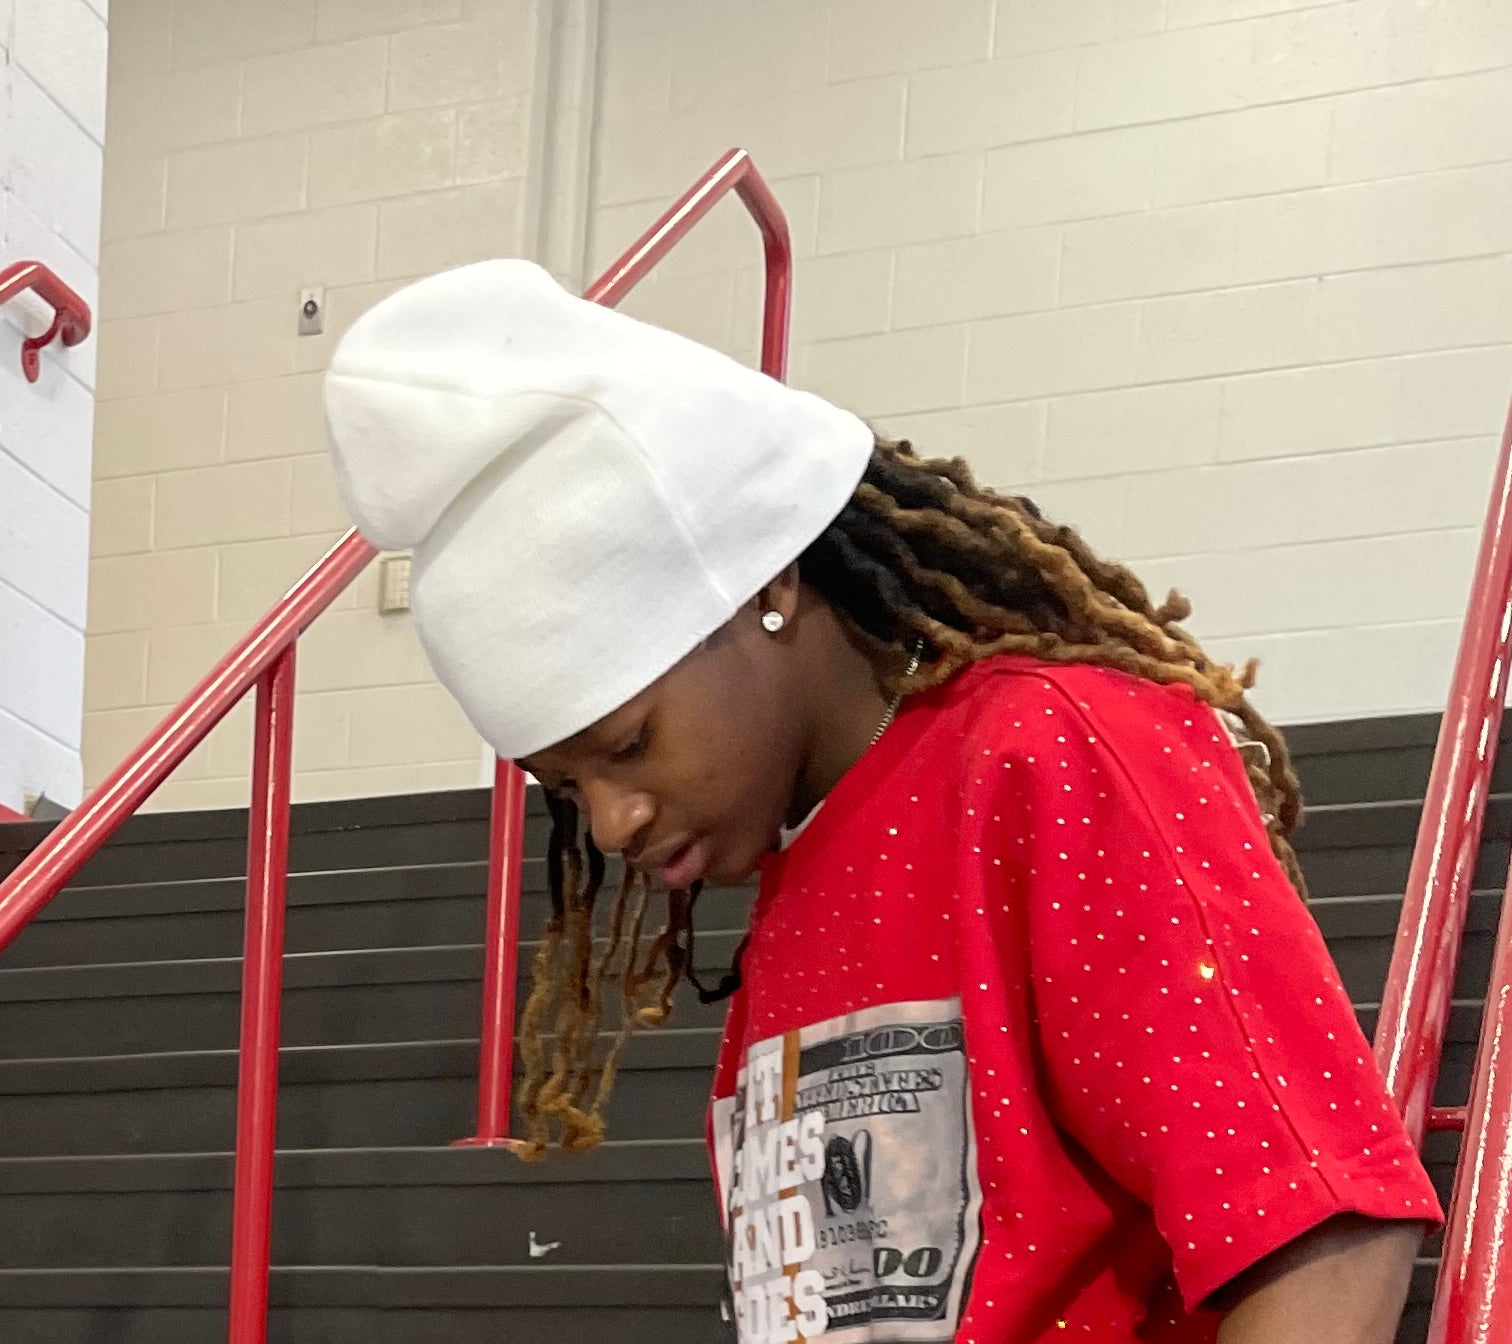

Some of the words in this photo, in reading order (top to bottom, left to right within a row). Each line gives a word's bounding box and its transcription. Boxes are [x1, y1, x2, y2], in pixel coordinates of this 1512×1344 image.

[746, 1051, 785, 1128] IT
[731, 1111, 826, 1204] MES
[732, 1195, 816, 1283] AND
